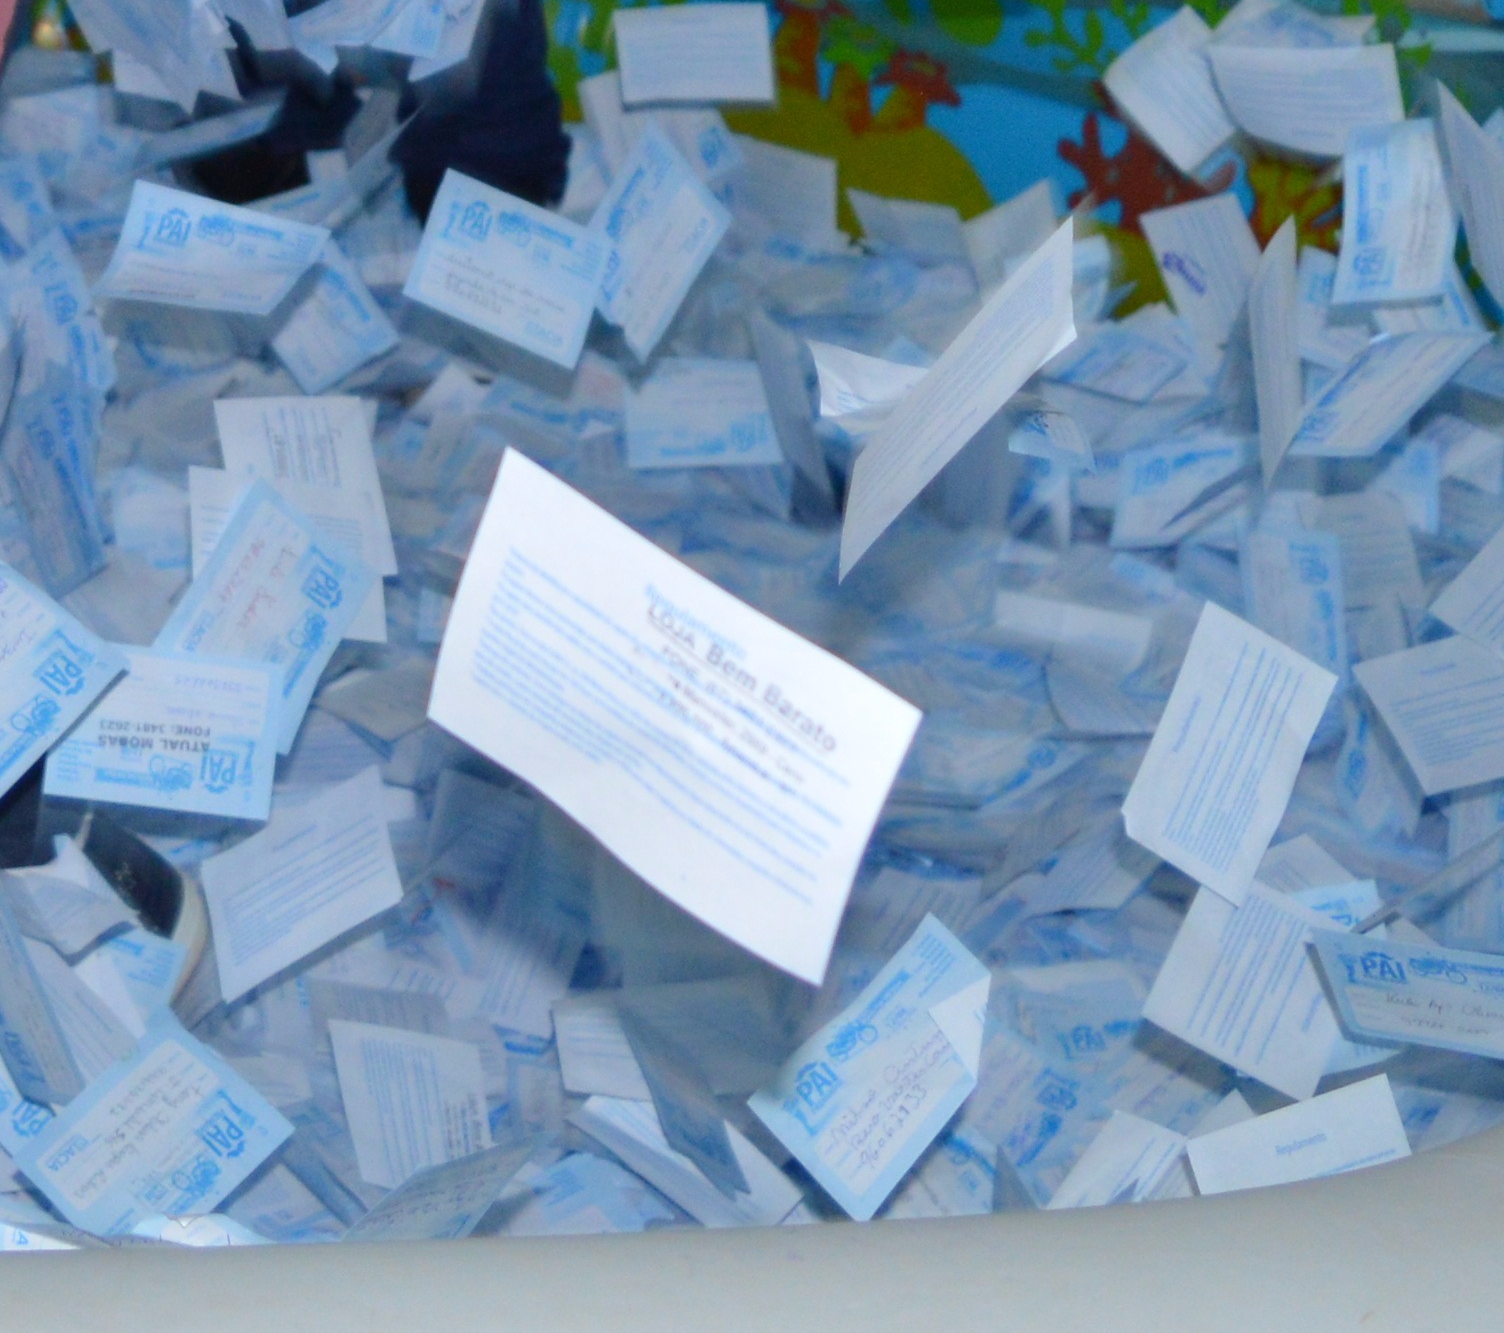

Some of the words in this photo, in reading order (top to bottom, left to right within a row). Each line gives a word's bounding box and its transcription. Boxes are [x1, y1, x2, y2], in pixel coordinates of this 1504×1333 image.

[155, 218, 191, 245] PAI
[298, 565, 342, 608] PAI
[36, 652, 83, 695] PAI
[645, 604, 699, 648] LOJA
[703, 643, 759, 691] Bem
[760, 683, 841, 753] Barato
[160, 737, 209, 751] ATUAL
[170, 724, 210, 736] FONE:
[199, 752, 236, 784] PAI
[1357, 954, 1409, 981] PAI
[795, 1060, 838, 1107] PAI
[199, 1113, 245, 1157] PAI
[1275, 1132, 1327, 1156] Regulamento
[47, 1144, 77, 1172] ACIA
